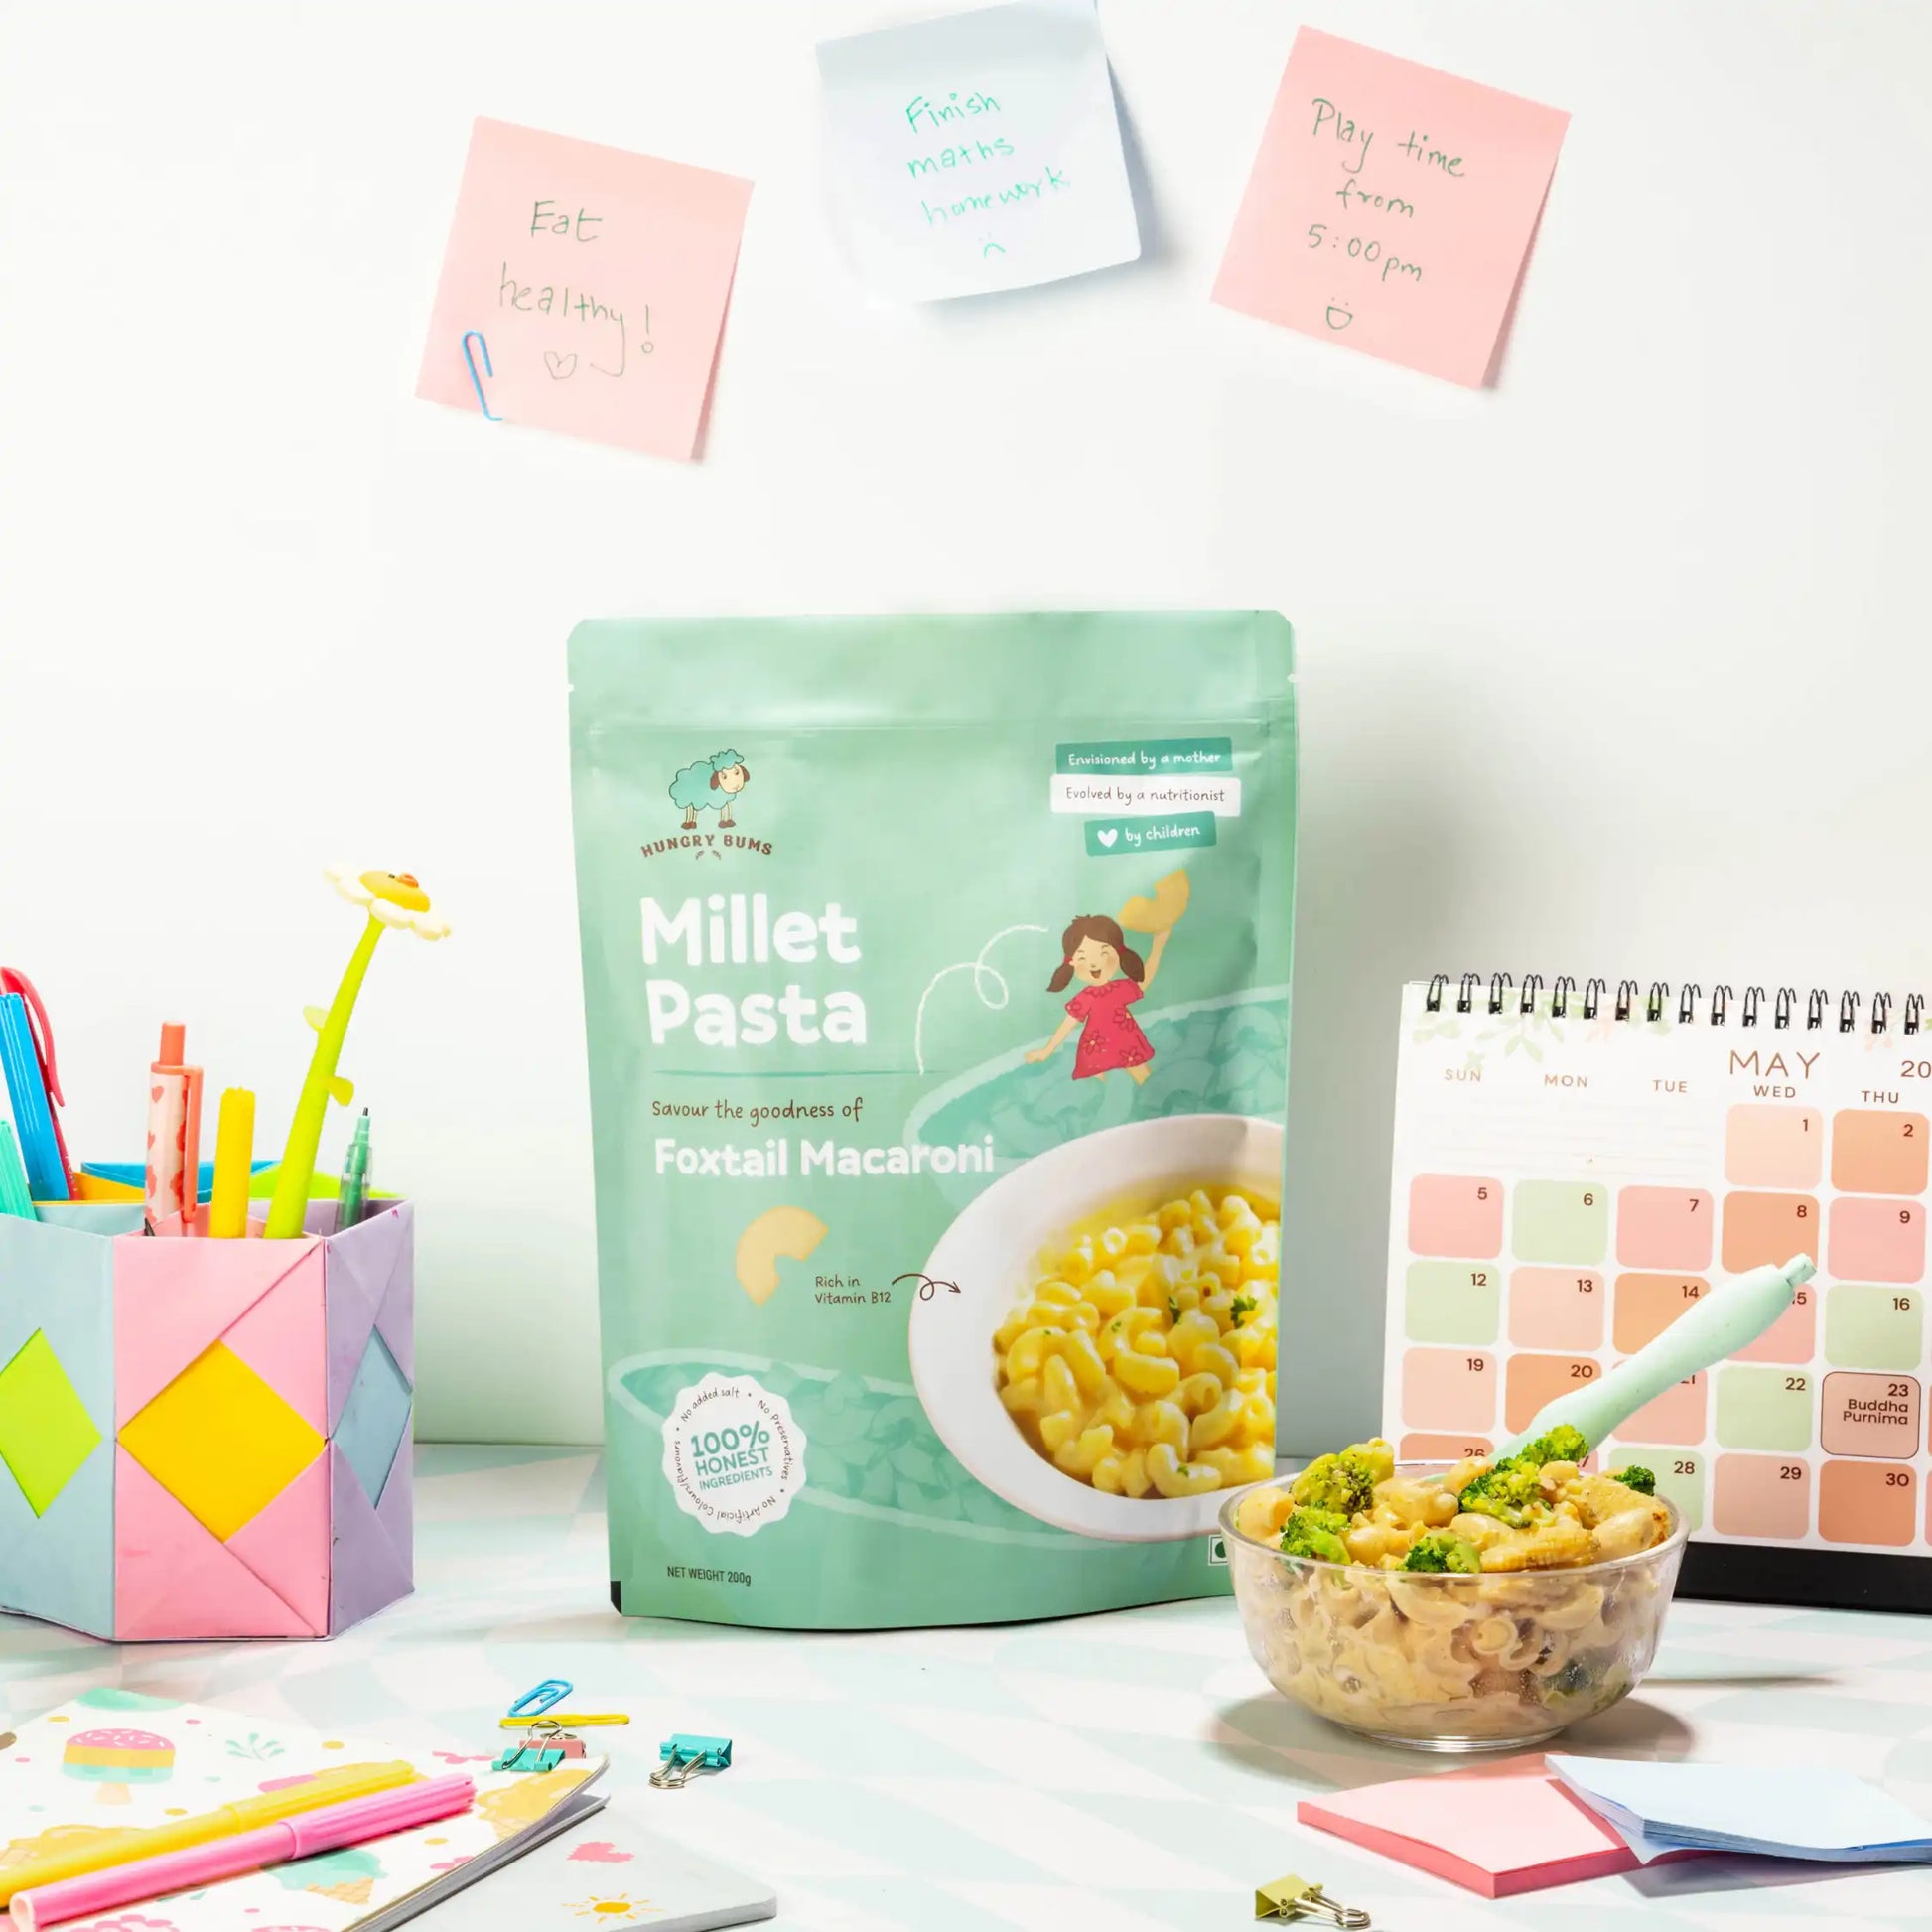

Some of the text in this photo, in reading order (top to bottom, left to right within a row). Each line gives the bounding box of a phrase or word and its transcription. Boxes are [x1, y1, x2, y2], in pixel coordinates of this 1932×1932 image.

[905, 92, 1001, 134] Finish
[1311, 97, 1465, 177] Play time
[907, 137, 1015, 179] maths
[921, 166, 1071, 225] homework
[1336, 178, 1414, 218] from
[530, 200, 603, 242] Eat
[1068, 751, 1136, 766] Envisioned
[1141, 750, 1156, 770] by
[1173, 751, 1221, 763] mother
[1066, 786, 1111, 800] Evolved
[1117, 787, 1132, 806] by
[1150, 789, 1225, 802] nutritionist
[640, 834, 772, 858] HUNGRY BUMS
[1125, 824, 1201, 847] by children
[639, 892, 862, 967] Millet
[645, 979, 869, 1048] Pasta
[1729, 1049, 1821, 1081] MAY
[1444, 1067, 1899, 1104] SUN MON TUE WED THU
[651, 1096, 864, 1127] Savour the goodness of
[1803, 1119, 1913, 1137] 1 2
[654, 1134, 994, 1177] Foxtail Macaroni
[1478, 1187, 1910, 1223] 5 6 7 8 9
[815, 1274, 861, 1288] Rich in
[1471, 1274, 1486, 1286] 12
[1578, 1280, 1592, 1292] 13
[1682, 1286, 1699, 1298] 14
[1893, 1298, 1909, 1310] 16
[815, 1291, 891, 1304] Vitamin B12
[1467, 1359, 1483, 1371] 19
[1571, 1365, 1592, 1378] 20
[1785, 1377, 1806, 1391] 22
[1888, 1383, 1909, 1397] 23
[681, 1387, 740, 1422] No added salt
[758, 1400, 770, 1414] No
[1843, 1411, 1908, 1425] Purnima
[1848, 1399, 1908, 1413] Buddha
[691, 1421, 770, 1457] 100%
[695, 1447, 769, 1476] HONEST
[1675, 1461, 1694, 1474] 28
[1781, 1467, 1801, 1479] 29
[1886, 1473, 1909, 1486] 30
[699, 1466, 773, 1491] INGREDIENTS
[717, 1509, 760, 1524] Artificial
[762, 1496, 776, 1508] No
[667, 1566, 751, 1587] NET WEIGHT 200g
